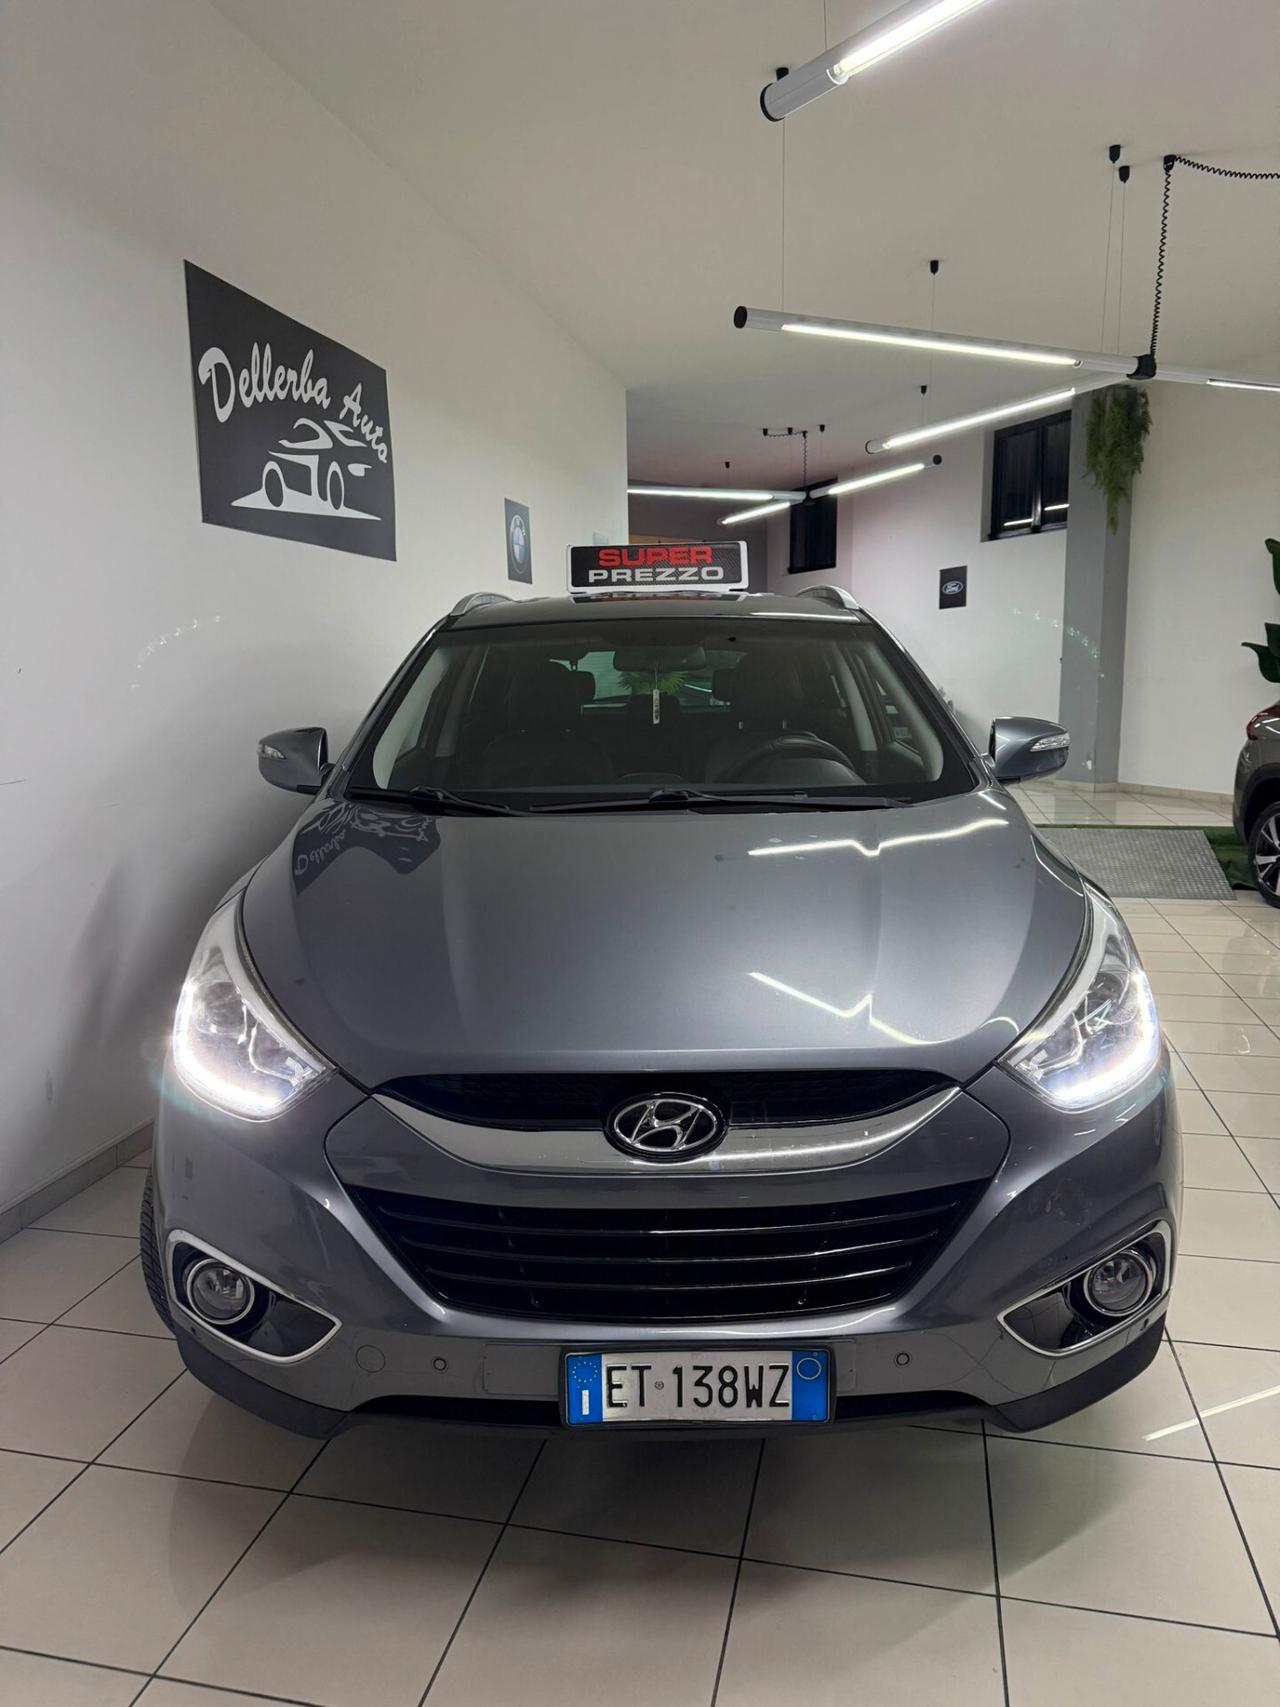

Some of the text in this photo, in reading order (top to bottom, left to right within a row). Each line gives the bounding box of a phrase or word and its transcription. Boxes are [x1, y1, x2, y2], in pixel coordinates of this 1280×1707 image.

[198, 342, 388, 463] Dellerba Auto
[598, 546, 713, 567] SUPER
[588, 566, 725, 583] PREZZO
[606, 1364, 790, 1408] ET 138WZ
